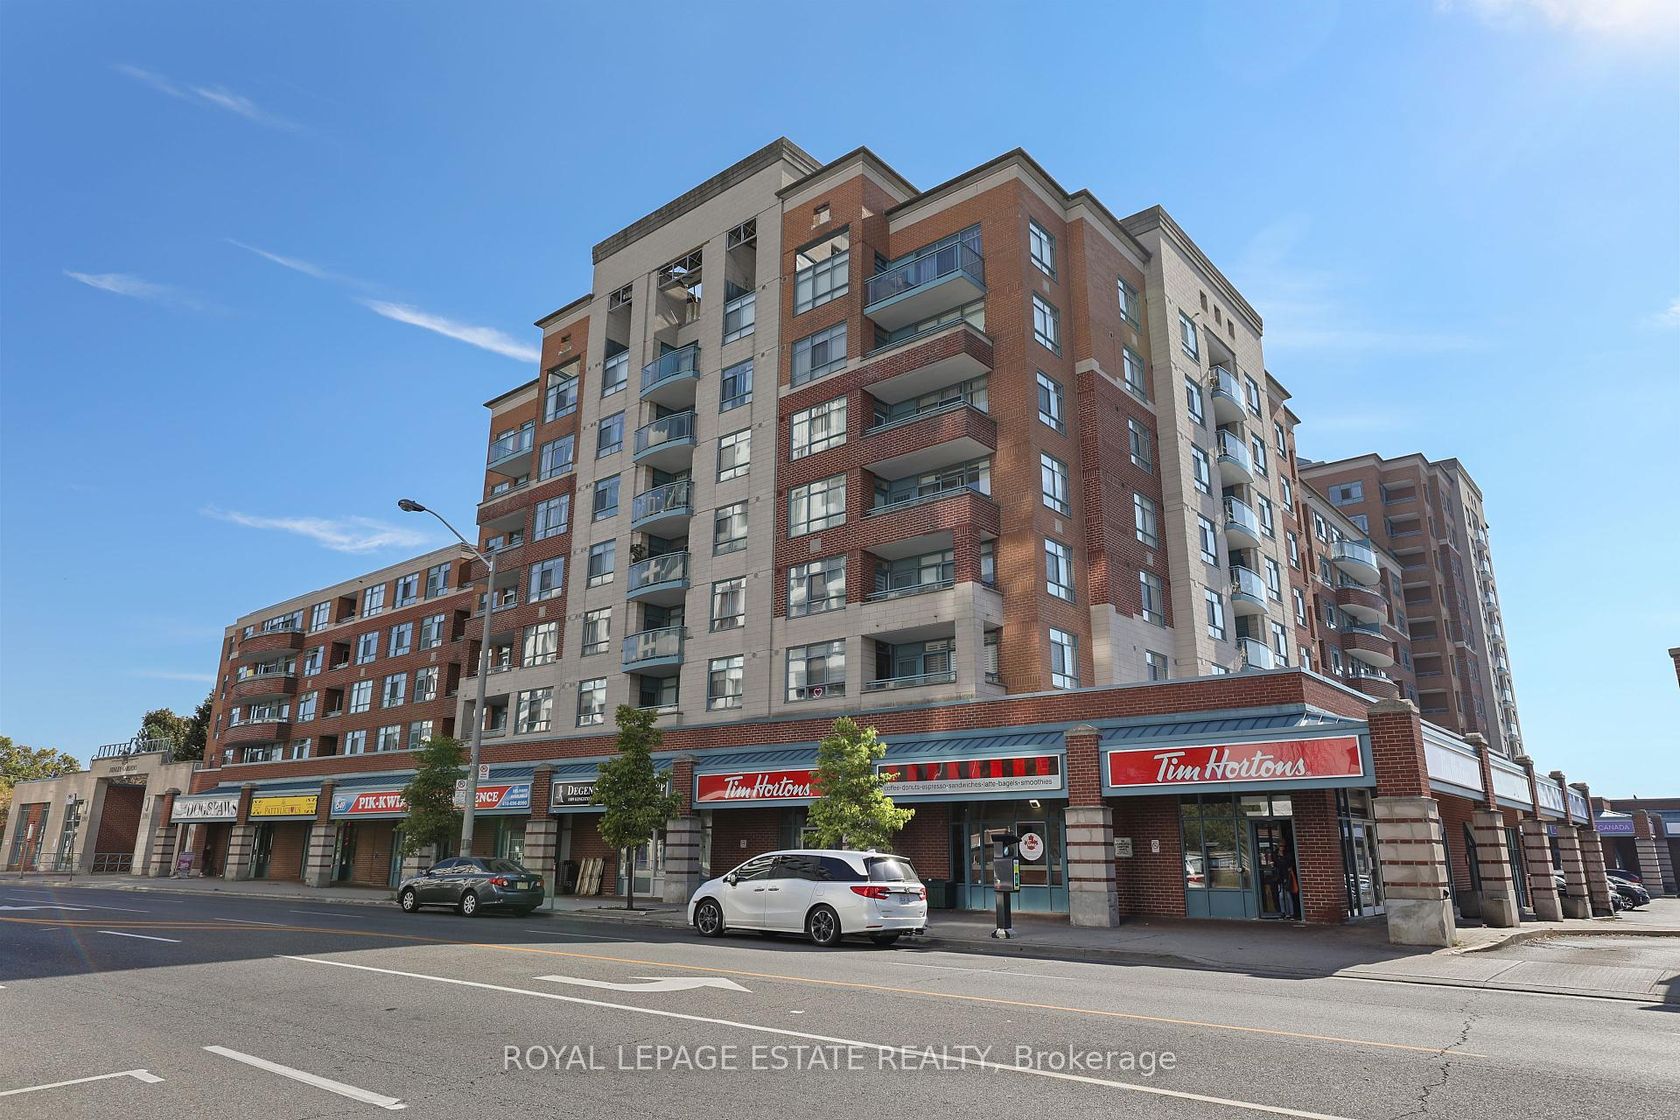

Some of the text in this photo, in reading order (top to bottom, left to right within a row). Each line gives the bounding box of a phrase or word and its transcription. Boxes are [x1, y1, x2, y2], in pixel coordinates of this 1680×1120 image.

[1153, 747, 1306, 783] Tim Hortons
[724, 773, 811, 799] Tim Hortons
[1597, 823, 1630, 831] CANADA
